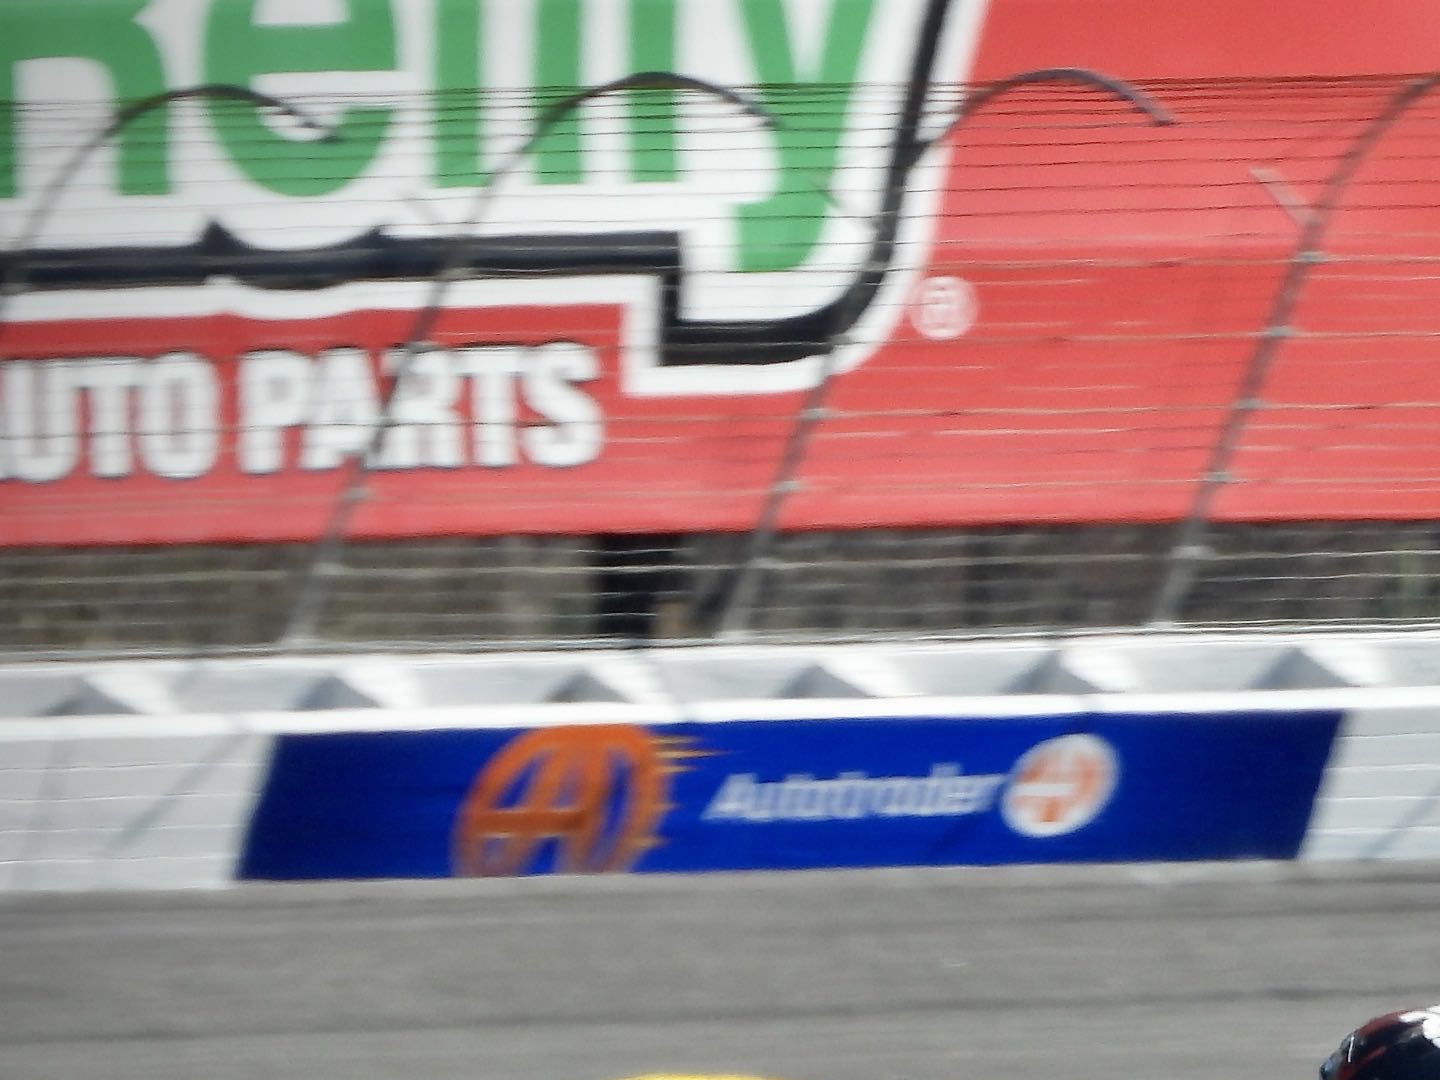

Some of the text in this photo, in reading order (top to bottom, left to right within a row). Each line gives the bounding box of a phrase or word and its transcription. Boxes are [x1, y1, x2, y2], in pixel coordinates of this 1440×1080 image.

[0, 342, 604, 482] UTO PARTS
[700, 762, 1005, 822] Autotrader
